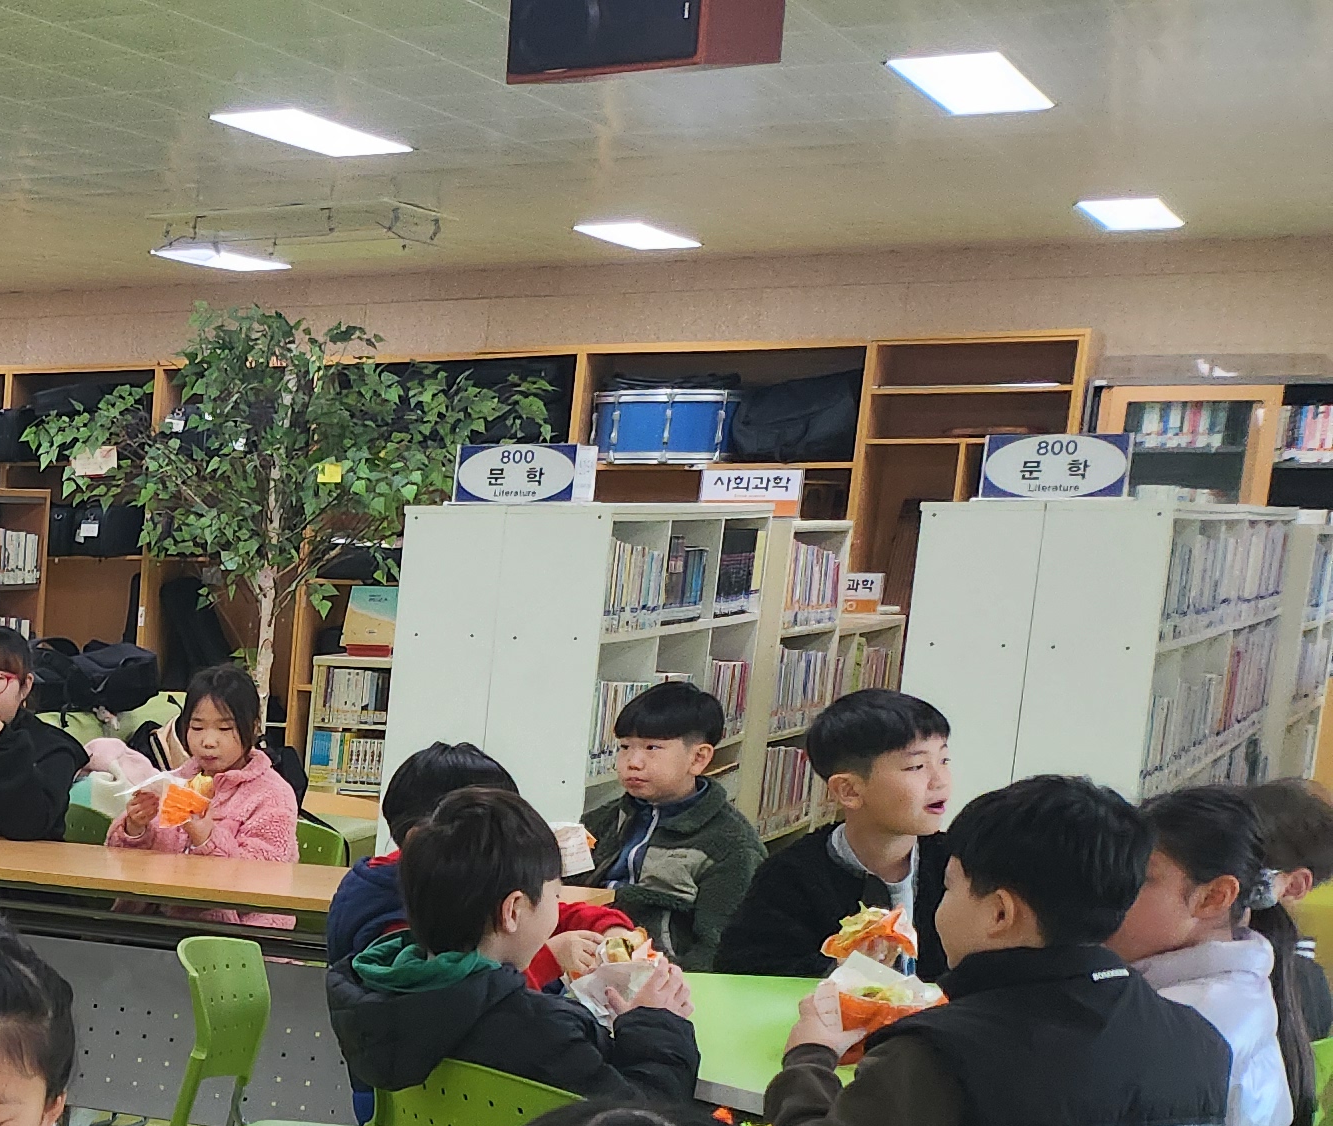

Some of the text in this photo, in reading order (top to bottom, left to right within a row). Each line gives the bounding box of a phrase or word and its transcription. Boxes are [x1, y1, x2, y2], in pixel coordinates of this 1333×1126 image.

[1036, 439, 1078, 456] 800
[500, 449, 535, 465] 800
[713, 475, 792, 492] 사회과학
[1027, 482, 1080, 493] Literature
[493, 488, 537, 498] Literature
[846, 578, 875, 592] 과학
